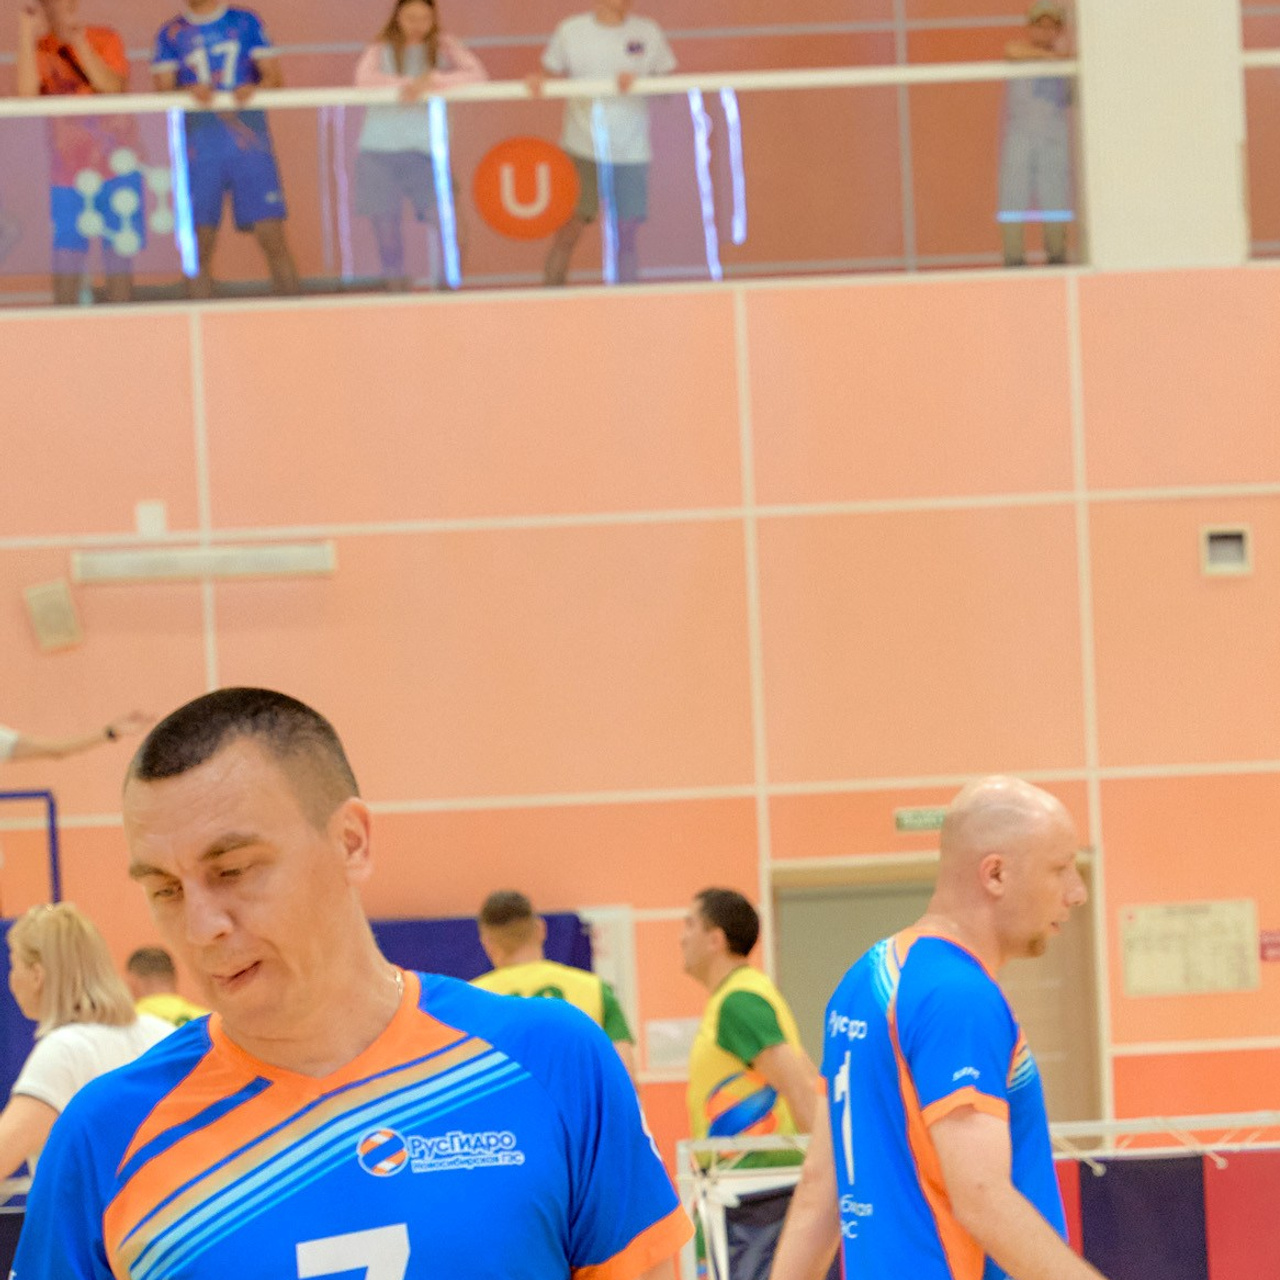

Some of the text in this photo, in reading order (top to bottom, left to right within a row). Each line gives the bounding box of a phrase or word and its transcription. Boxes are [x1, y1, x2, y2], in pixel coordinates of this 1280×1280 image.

[184, 38, 241, 89] 17
[500, 163, 550, 219] U
[408, 1131, 516, 1160] РусГидро
